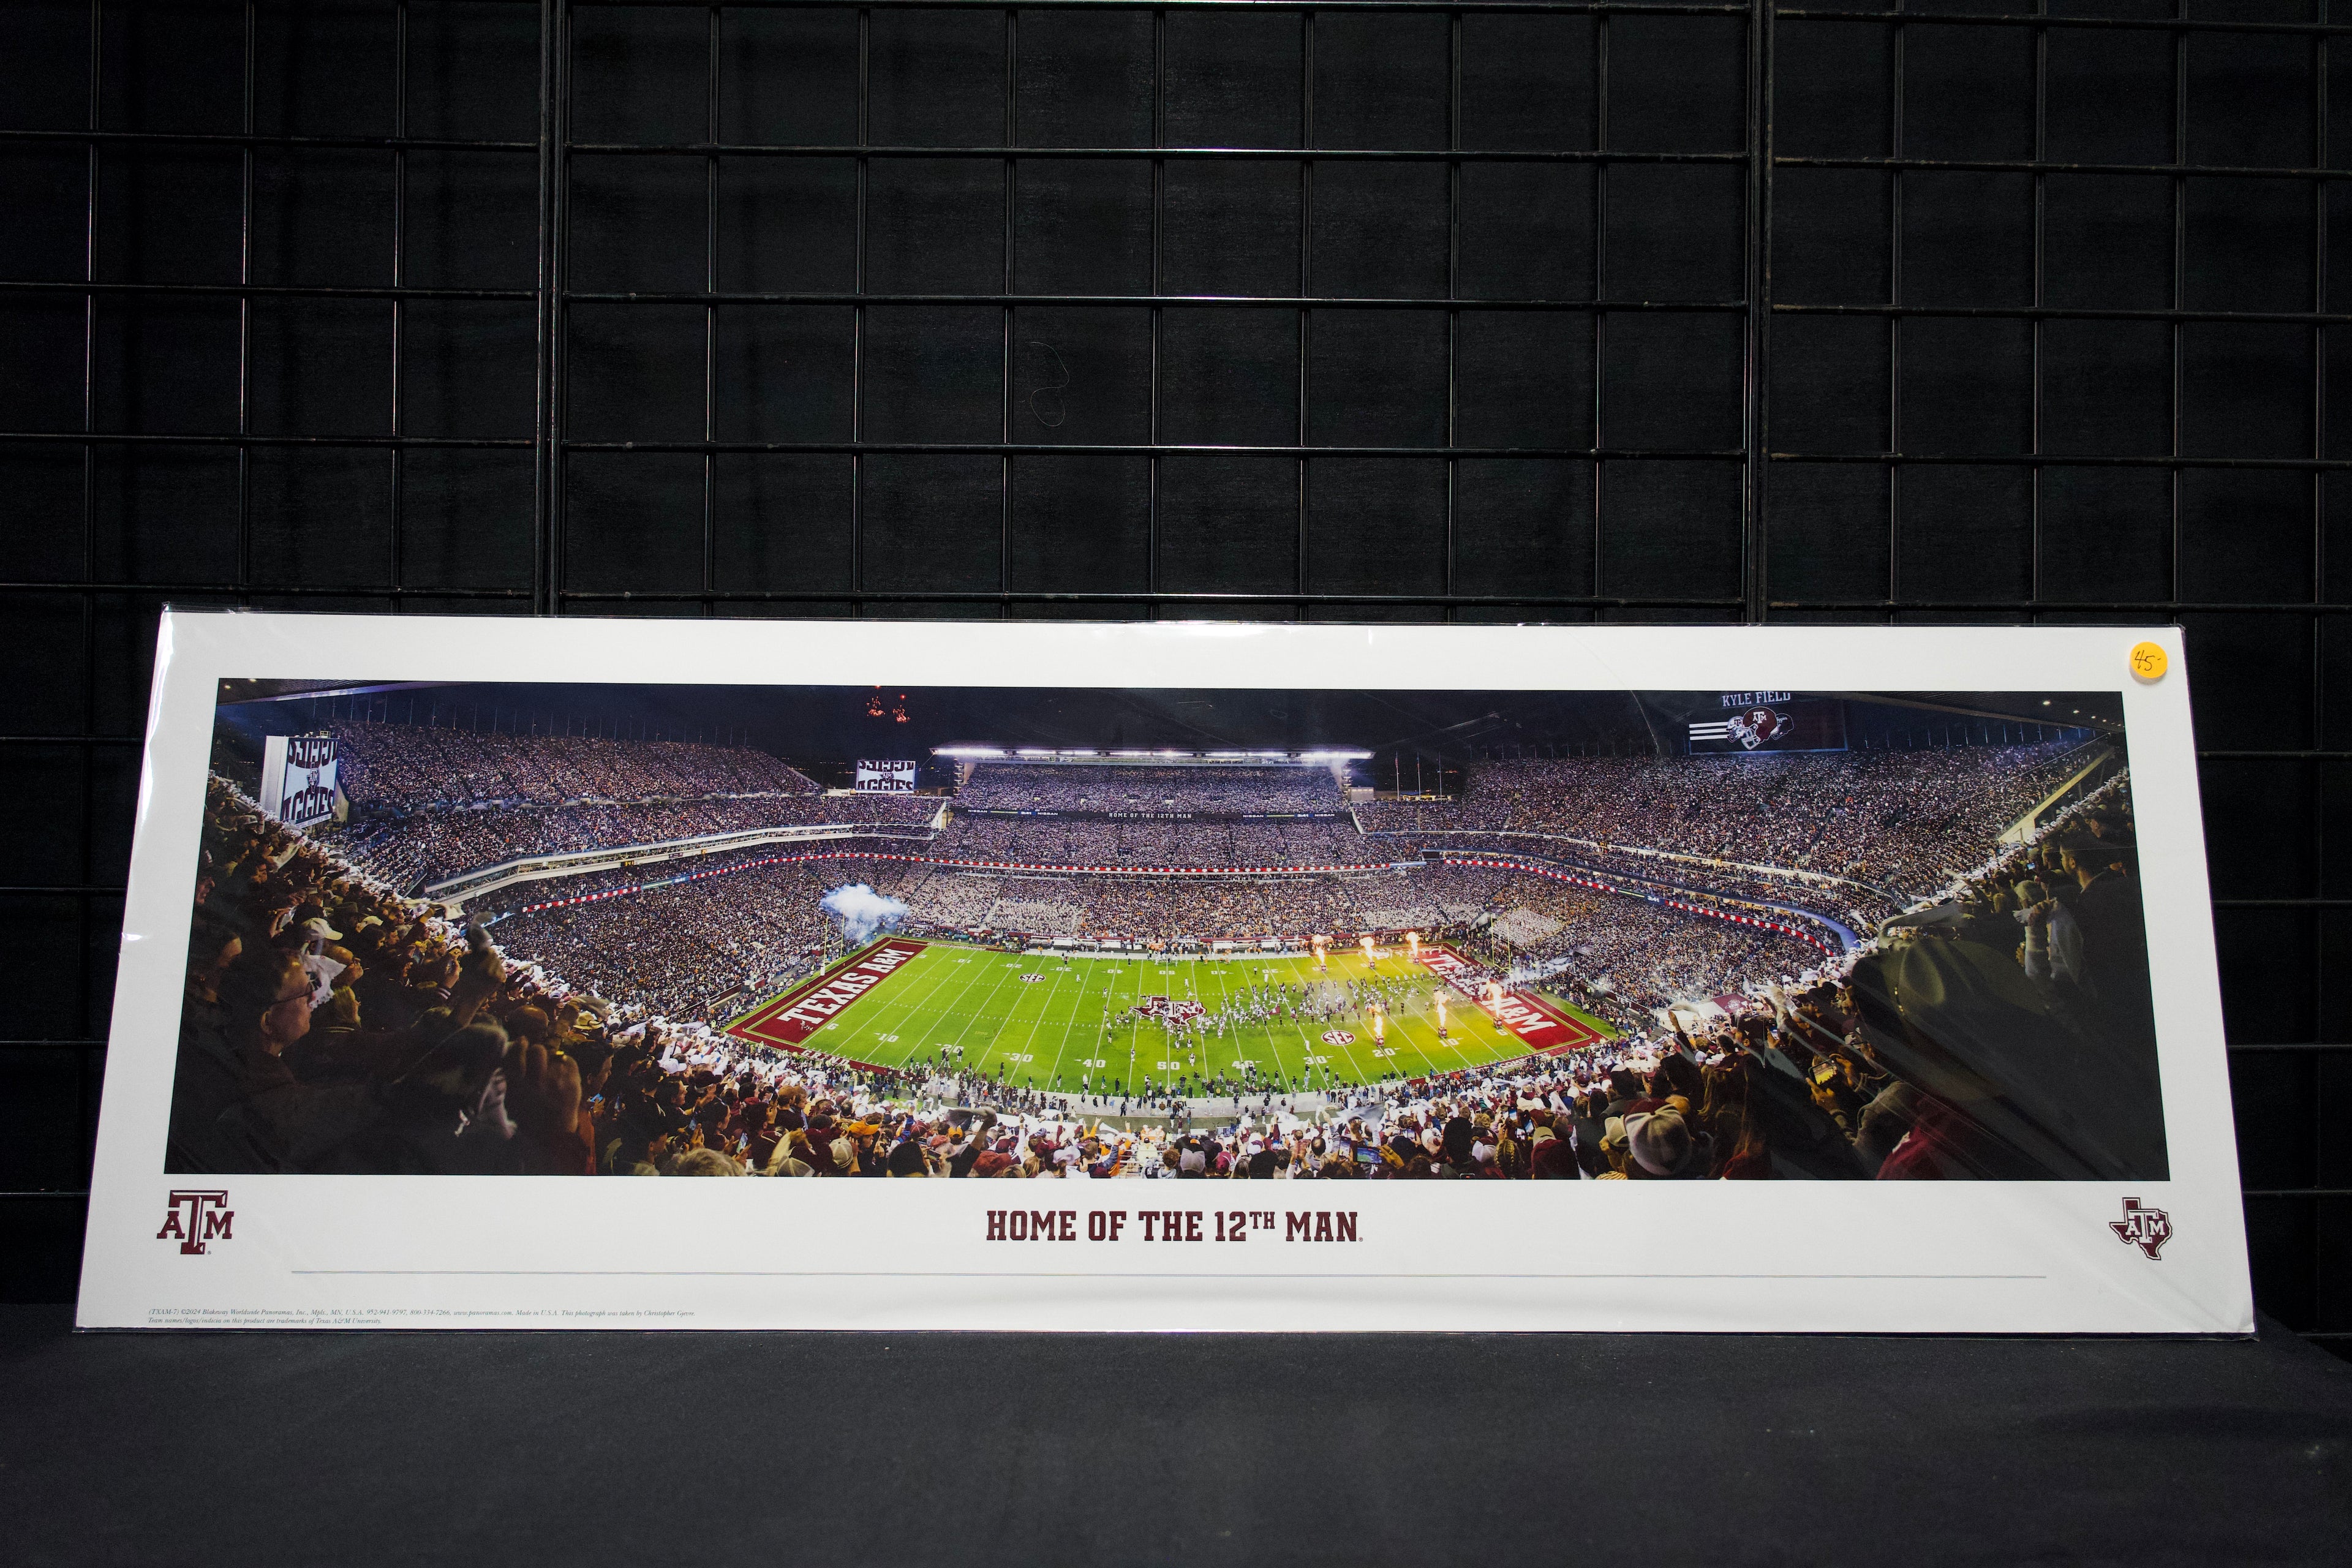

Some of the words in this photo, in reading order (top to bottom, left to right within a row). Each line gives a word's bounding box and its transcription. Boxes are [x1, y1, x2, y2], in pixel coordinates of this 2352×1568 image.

[1722, 693, 1752, 707] KYLE
[1755, 691, 1791, 704] FIELD
[1020, 974, 1045, 982] SEC
[776, 972, 880, 1025] TEXAS
[857, 948, 915, 974] A&M
[878, 1034, 899, 1042] 10
[1326, 1030, 1354, 1045] SEC
[1439, 1038, 1460, 1047] 10
[940, 1044, 965, 1054] 20
[1372, 1048, 1396, 1058] 20
[1009, 1053, 1034, 1063] 30
[1083, 1058, 1106, 1068] 40
[1303, 1055, 1328, 1065] 30
[1157, 1061, 1180, 1070] 50
[1231, 1060, 1254, 1069] 40
[986, 1210, 1077, 1241] HOME
[1088, 1210, 1126, 1242] OF
[1138, 1211, 1203, 1242] THE
[1215, 1211, 1276, 1242] 12TH
[1286, 1212, 1358, 1242] MAN
[202, 1308, 228, 1317] Blakeway
